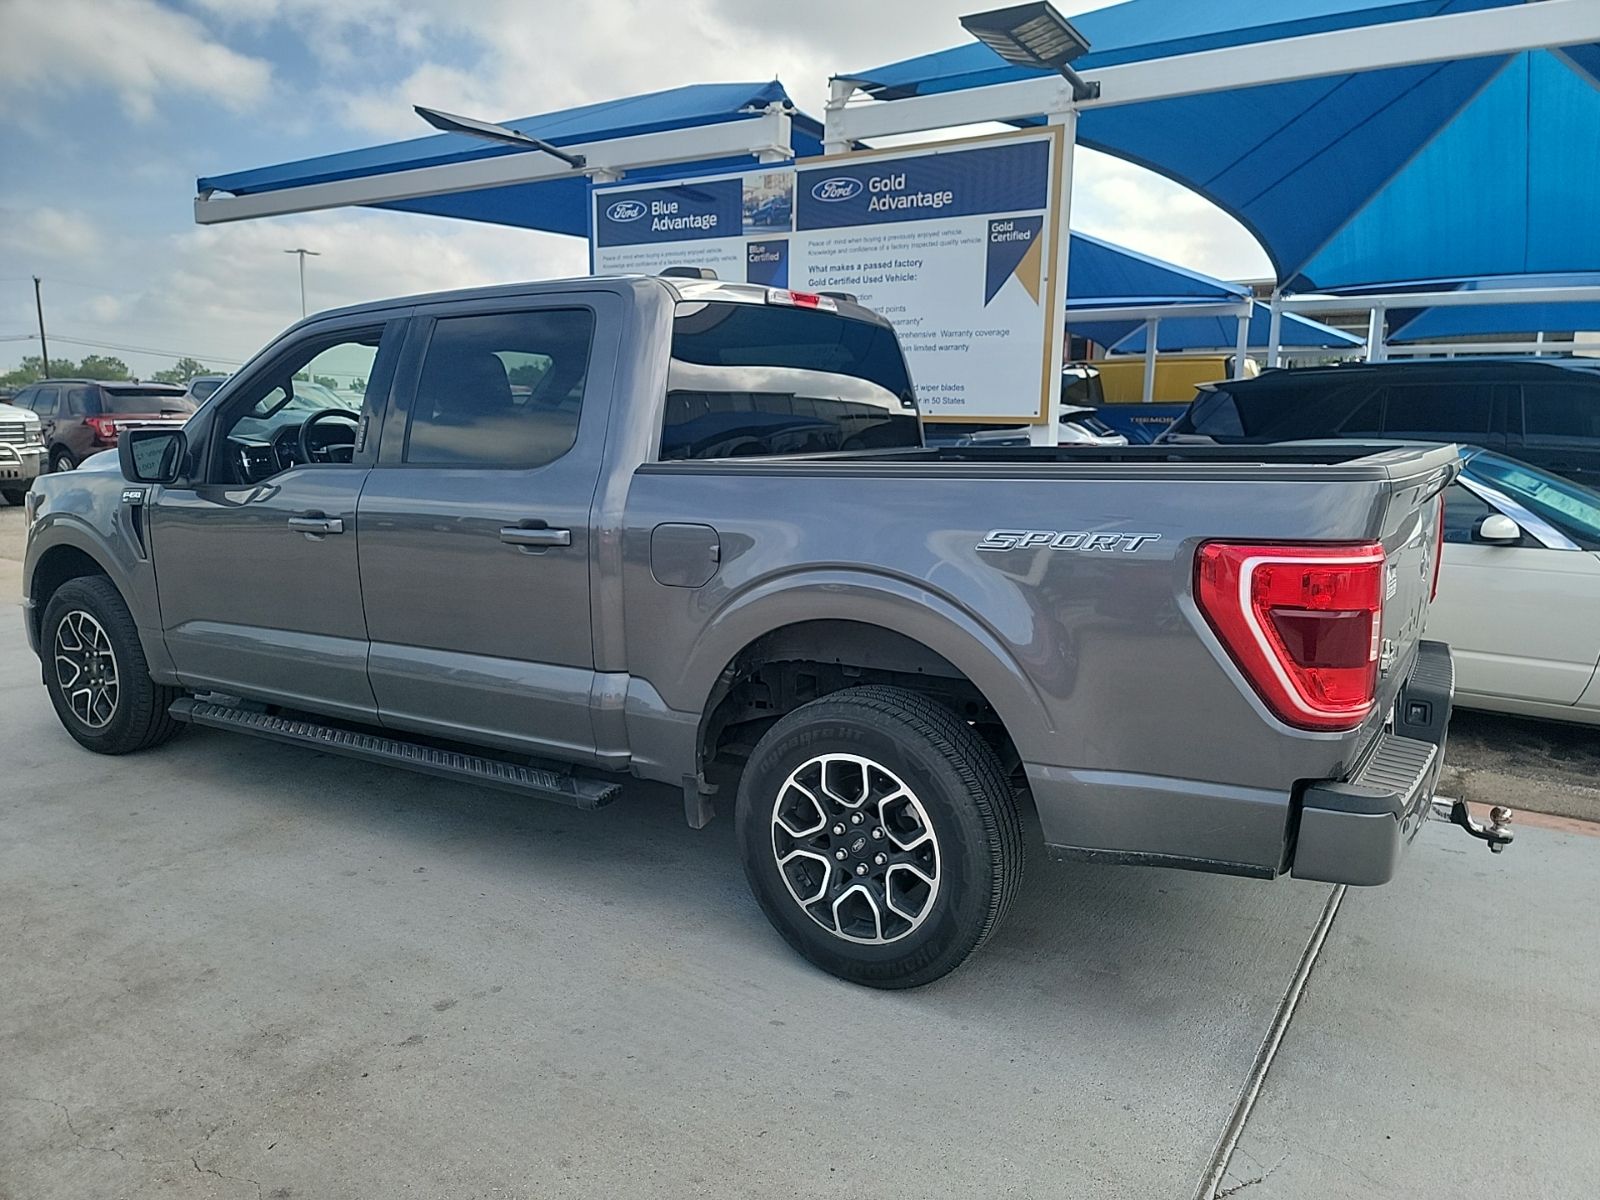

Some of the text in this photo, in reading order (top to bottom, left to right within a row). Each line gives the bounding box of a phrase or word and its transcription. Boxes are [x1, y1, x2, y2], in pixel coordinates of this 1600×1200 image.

[868, 172, 906, 193] Gold
[651, 200, 679, 215] Blue
[868, 191, 954, 212] Advantage
[651, 213, 718, 231] Advantage
[991, 221, 1014, 233] Gold
[990, 229, 1031, 243] Certified
[748, 251, 780, 263] Certified
[808, 263, 828, 274] What
[829, 263, 855, 273] makes
[863, 260, 892, 273] passed
[894, 258, 923, 270] factory
[808, 272, 918, 287] Gold Certified Used Vehicle:
[885, 304, 907, 315] points
[940, 329, 973, 339] Warranty
[975, 328, 1010, 338] coverage
[913, 343, 937, 352] limited
[938, 343, 970, 353] warranty
[920, 384, 940, 393] wiper
[940, 383, 965, 392] blades
[923, 396, 931, 405] in
[931, 396, 942, 405] 50
[942, 395, 966, 405] States
[975, 529, 1161, 553] SPORT
